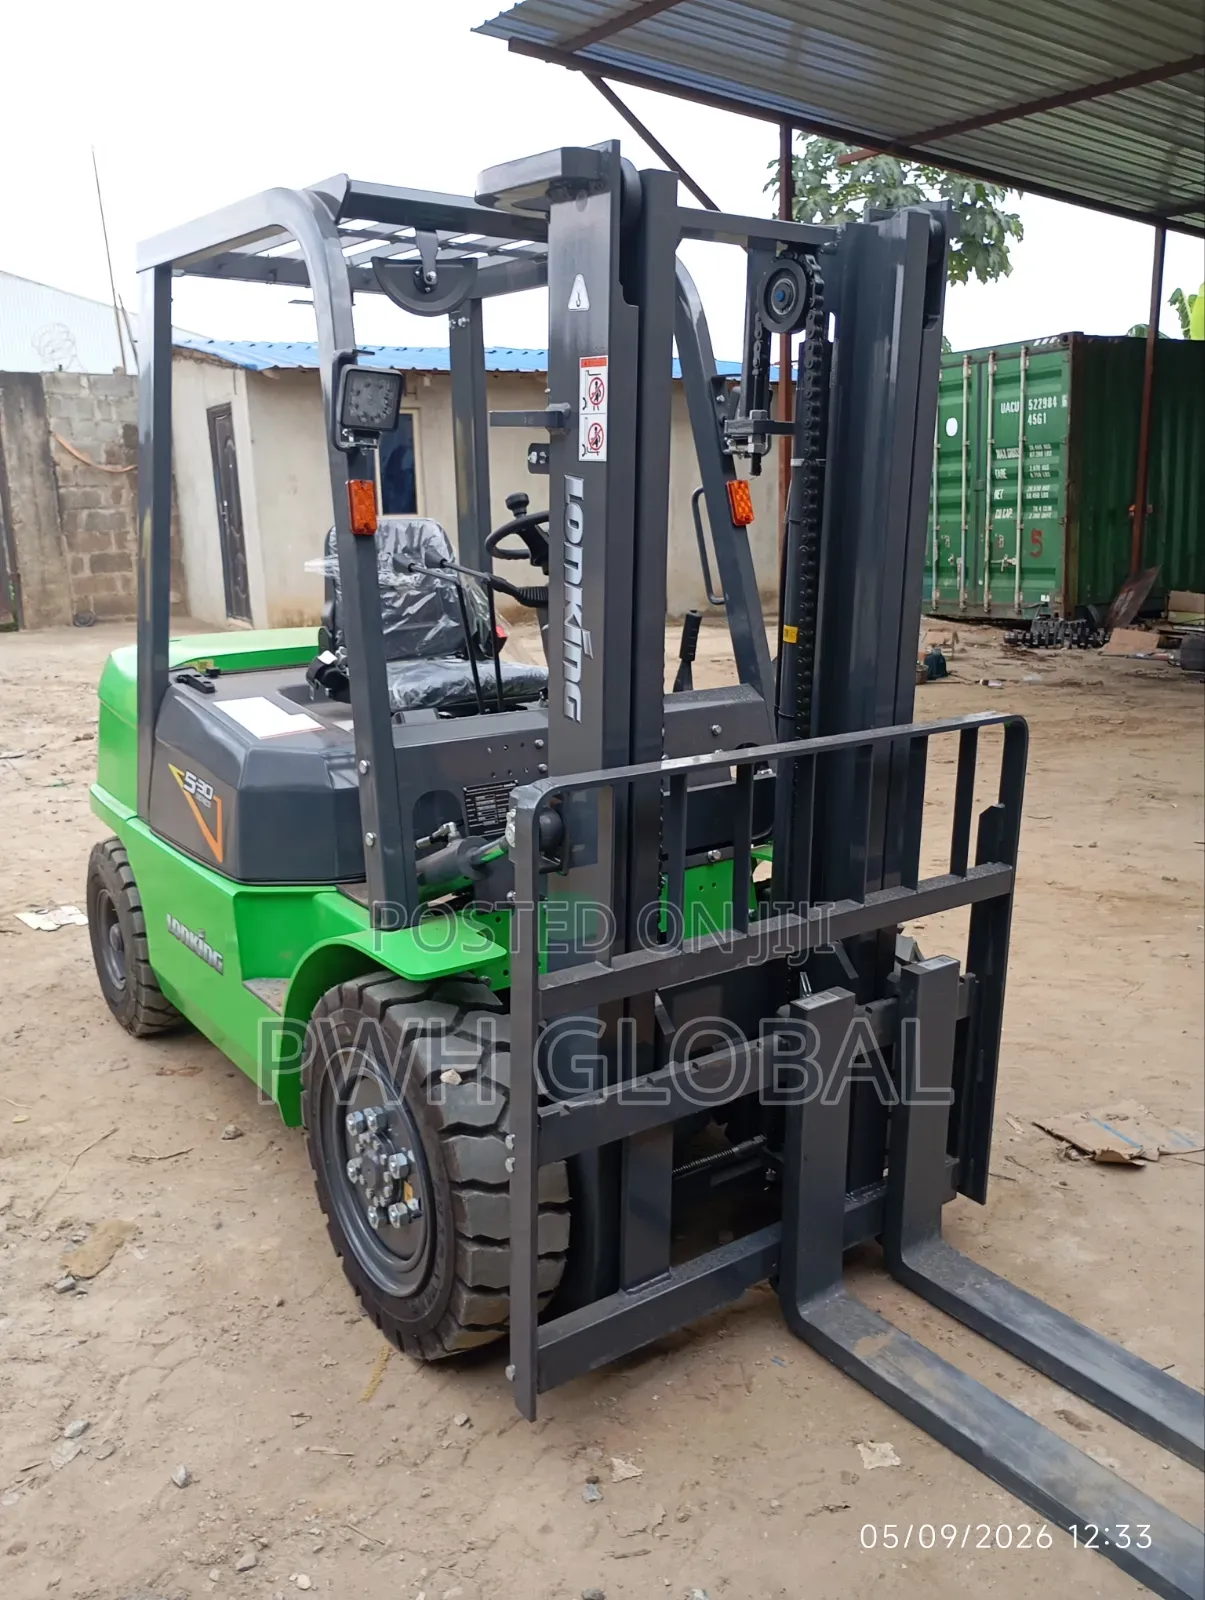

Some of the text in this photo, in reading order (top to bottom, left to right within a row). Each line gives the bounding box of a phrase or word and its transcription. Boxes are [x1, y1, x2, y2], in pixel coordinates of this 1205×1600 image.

[1001, 401, 1020, 414] UACU
[1028, 396, 1057, 411] 522984
[994, 467, 1007, 480] TARE
[994, 488, 1004, 500] NET
[1029, 528, 1043, 559] 5
